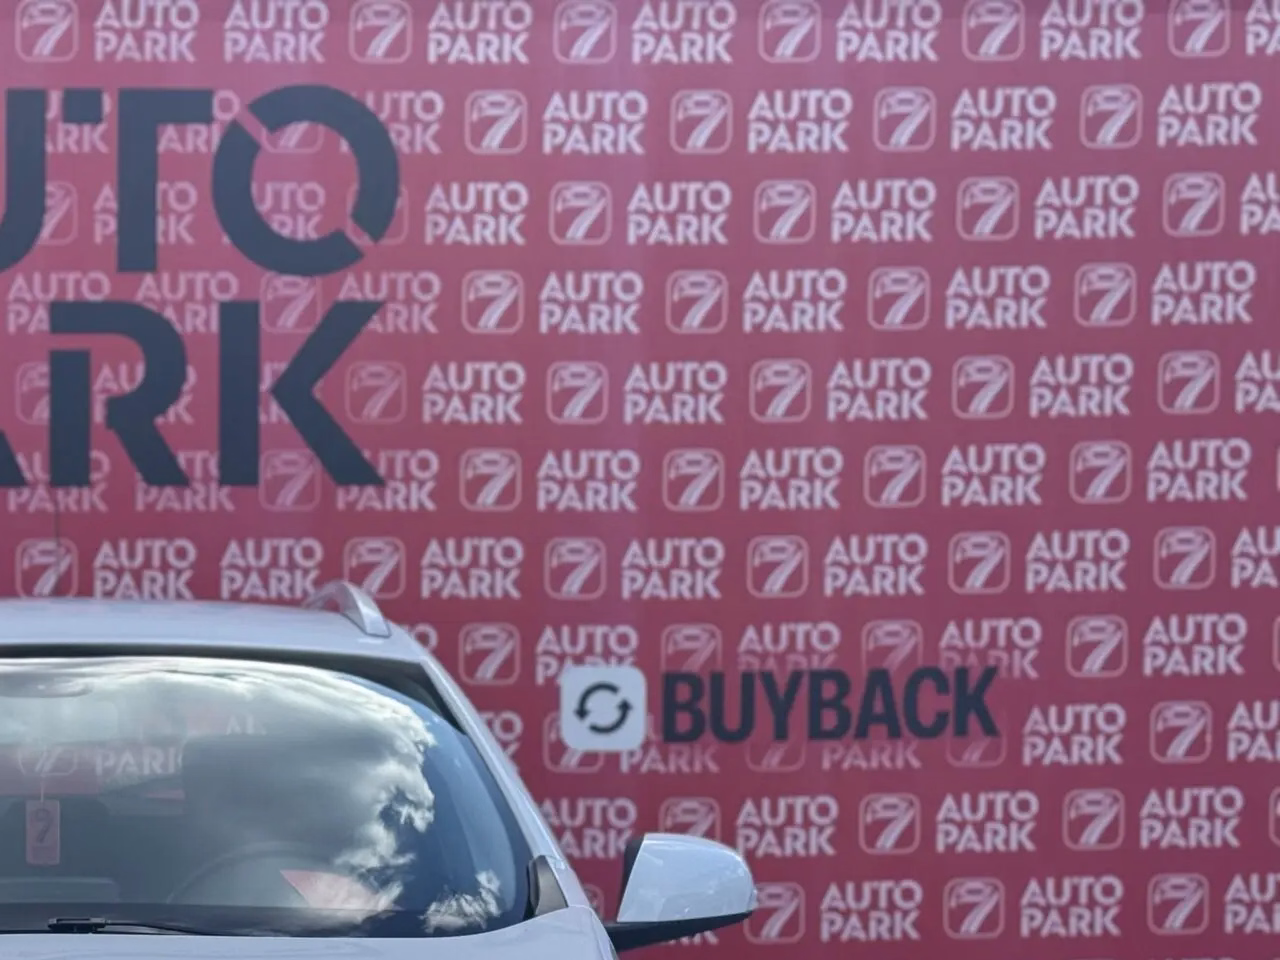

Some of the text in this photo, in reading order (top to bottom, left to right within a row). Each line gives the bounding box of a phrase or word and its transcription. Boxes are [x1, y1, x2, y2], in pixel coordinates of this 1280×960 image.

[224, 0, 328, 31] AUTO
[428, 0, 532, 31] AUTO
[632, 0, 736, 31] AUTO
[224, 30, 324, 63] PARK
[428, 32, 528, 64] PARK
[632, 32, 732, 64] PARK
[543, 90, 648, 123] AUTO
[748, 88, 853, 120] AUTO
[952, 86, 1056, 118] AUTO
[1158, 82, 1262, 113] AUTO
[543, 122, 644, 154] PARK
[748, 121, 848, 153] PARK
[951, 119, 1052, 150] PARK
[1157, 114, 1257, 146] PARK
[426, 181, 529, 212] AUTO
[627, 181, 731, 212] AUTO
[832, 178, 936, 210] AUTO
[1035, 175, 1139, 206] AUTO
[426, 212, 525, 245] PARK
[627, 213, 727, 245] PARK
[831, 209, 932, 242] PARK
[1035, 207, 1134, 239] PARK
[540, 271, 644, 303] AUTO
[743, 268, 847, 300] AUTO
[946, 265, 1050, 297] AUTO
[1152, 260, 1256, 294] AUTO
[540, 302, 639, 334] PARK
[743, 301, 843, 332] PARK
[946, 296, 1046, 329] PARK
[1152, 292, 1252, 325] PARK
[423, 361, 526, 393] AUTO
[624, 361, 727, 392] AUTO
[827, 357, 931, 390] AUTO
[1030, 353, 1133, 386] AUTO
[423, 393, 522, 423] PARK
[624, 393, 723, 424] PARK
[827, 389, 927, 421] PARK
[1030, 383, 1130, 417] PARK
[537, 449, 640, 481] AUTO
[740, 446, 843, 478] AUTO
[942, 443, 1046, 474] AUTO
[1148, 438, 1251, 469] AUTO
[537, 480, 636, 511] PARK
[740, 479, 839, 510] PARK
[942, 475, 1041, 506] PARK
[1147, 470, 1247, 501] PARK
[94, 538, 196, 569] AUTO
[221, 538, 323, 569] AUTO
[421, 537, 524, 568] AUTO
[621, 537, 725, 568] AUTO
[824, 533, 928, 564] AUTO
[1026, 529, 1130, 560] AUTO
[94, 569, 194, 599] PARK
[220, 569, 321, 600] PARK
[421, 567, 520, 598] PARK
[622, 569, 721, 599] PARK
[824, 565, 924, 597] PARK
[1026, 561, 1125, 592] PARK
[1144, 613, 1247, 644] AUTO
[1143, 645, 1243, 676] PARK
[662, 665, 1001, 744] BUYBACK
[1024, 703, 1126, 735] AUTO
[1023, 732, 1122, 765] PARK
[737, 795, 838, 828] AUTO
[936, 791, 1039, 823] AUTO
[1140, 786, 1243, 817] AUTO
[736, 826, 836, 857] PARK
[936, 821, 1035, 853] PARK
[1140, 818, 1239, 848] PARK
[820, 879, 923, 910] AUTO
[1021, 875, 1123, 907] AUTO
[821, 911, 919, 941] PARK
[1021, 904, 1119, 937] PARK
